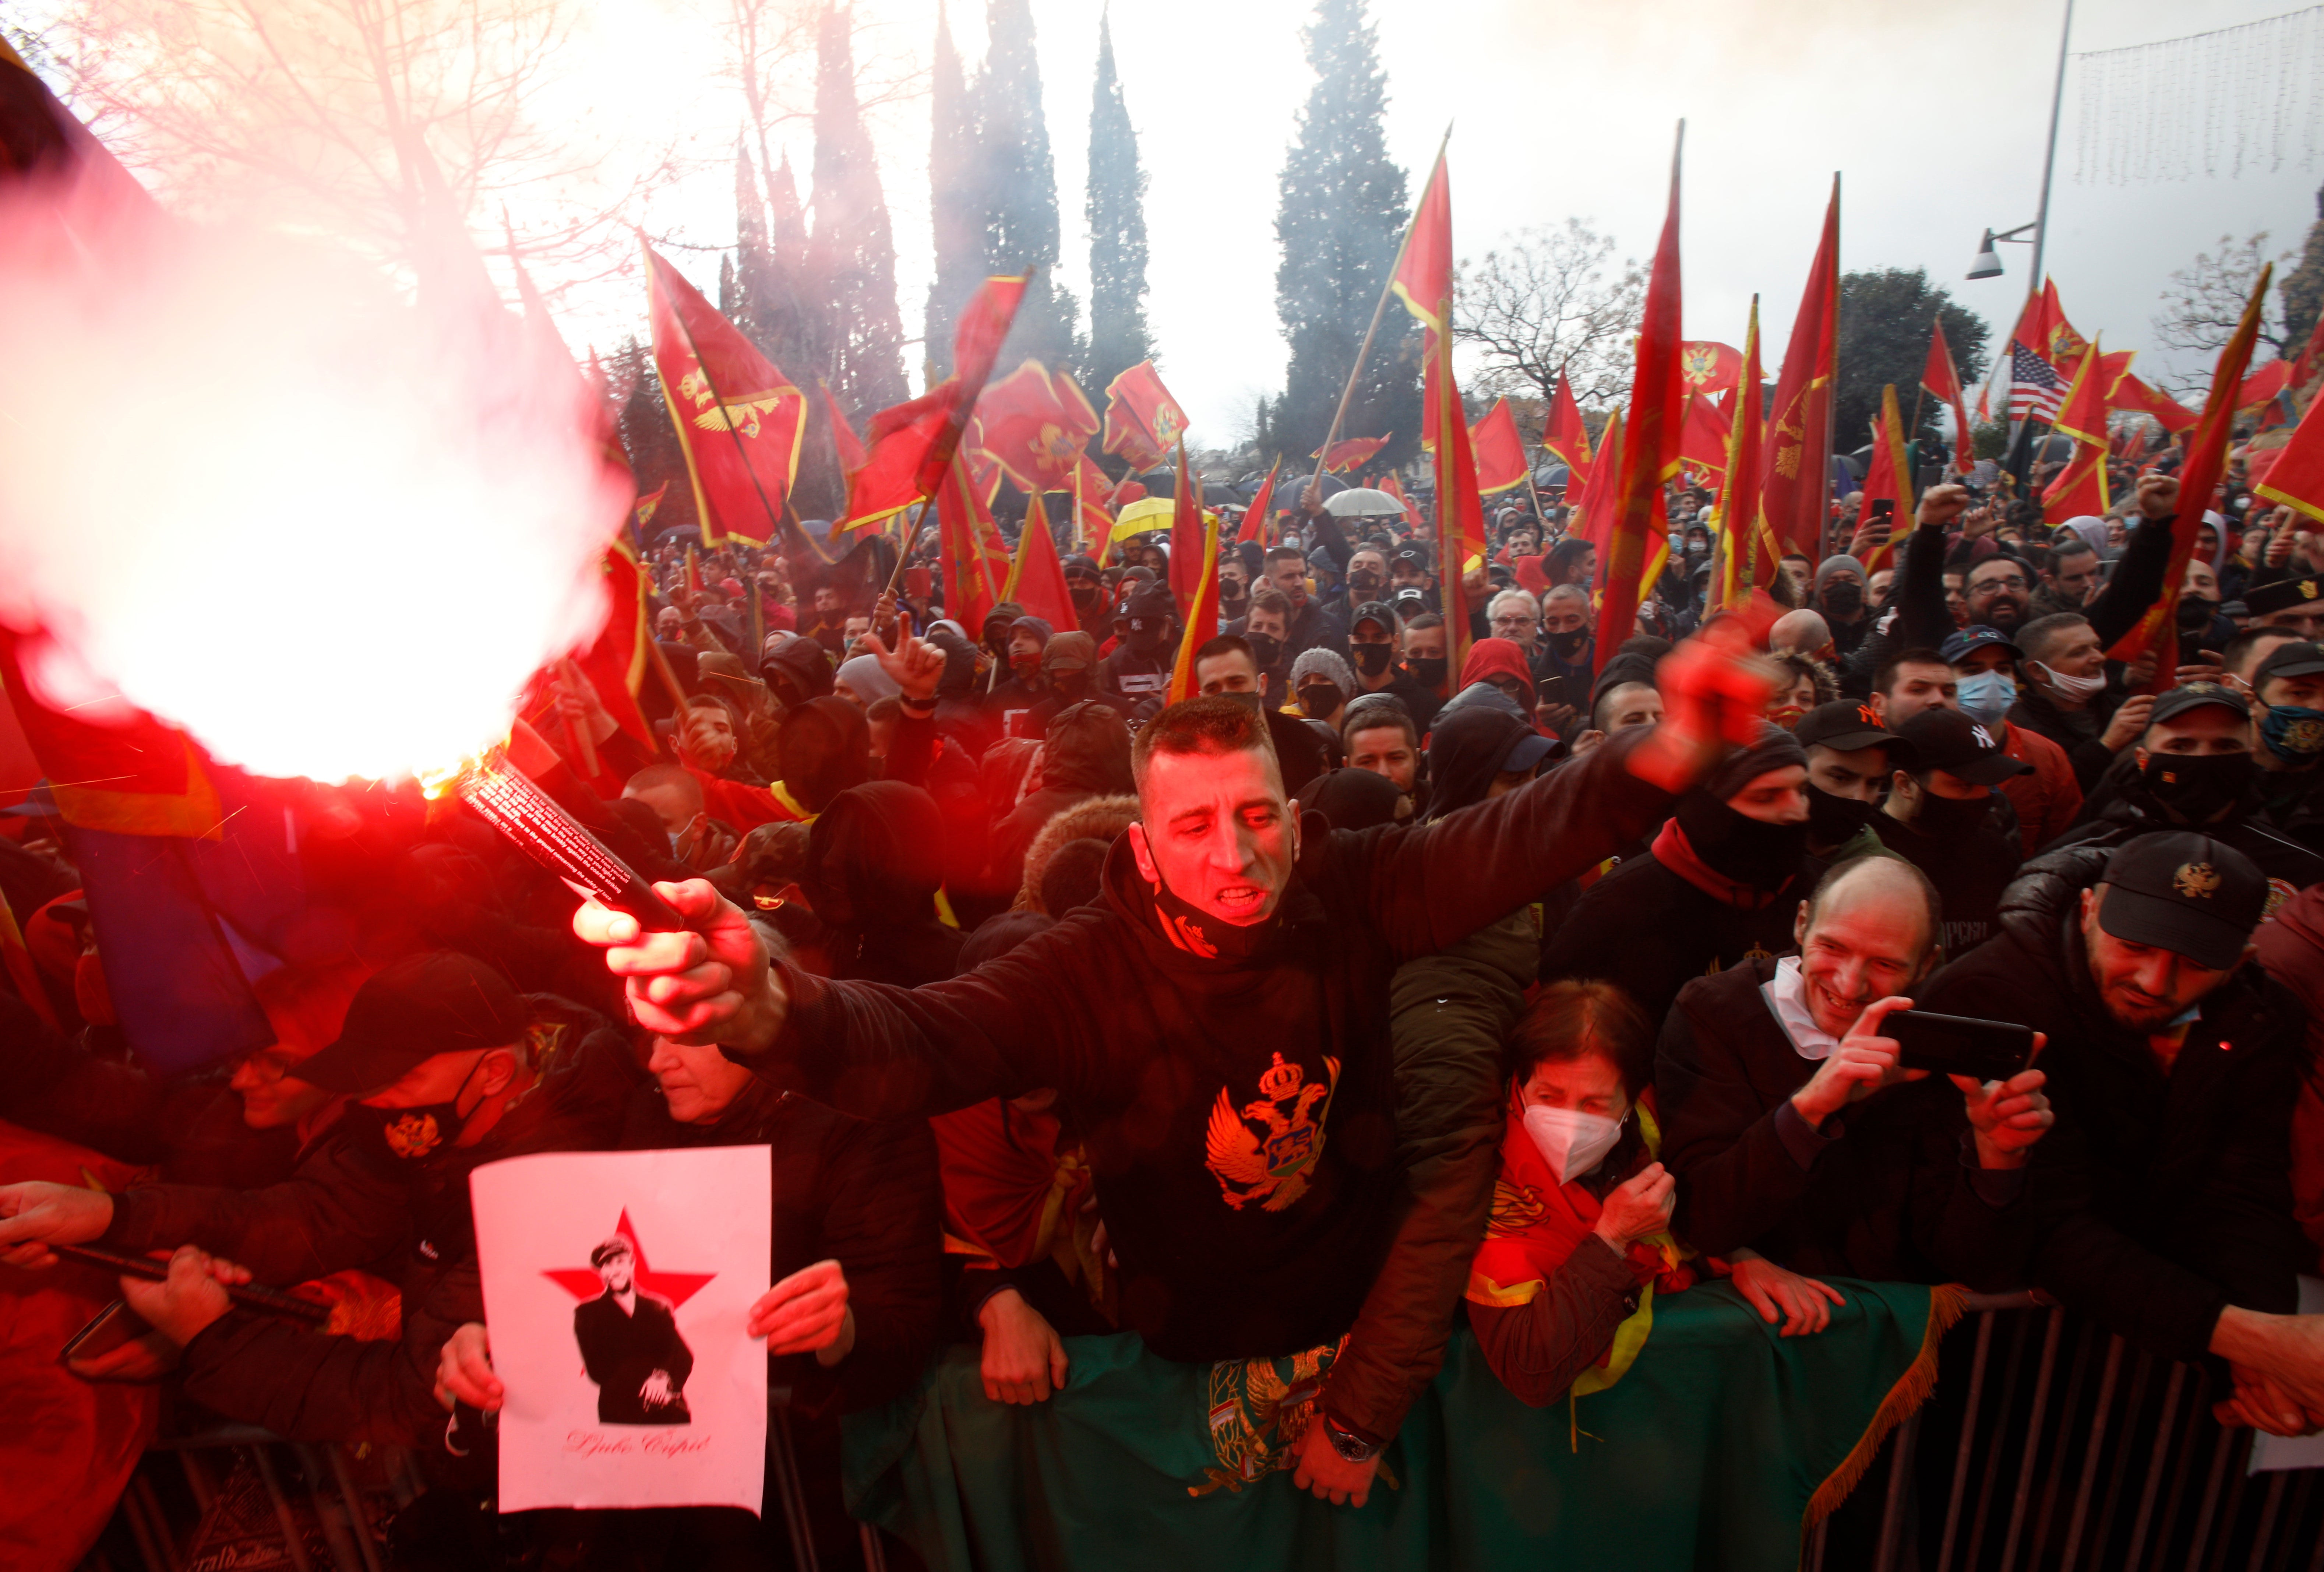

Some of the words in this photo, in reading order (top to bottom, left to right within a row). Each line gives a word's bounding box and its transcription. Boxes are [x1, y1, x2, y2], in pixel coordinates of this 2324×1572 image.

[523, 826, 532, 834] to
[529, 830, 539, 840] the
[536, 836, 555, 854] ground
[552, 850, 578, 873] concerning
[576, 870, 586, 879] the
[582, 876, 599, 890] safety
[531, 816, 542, 826] the
[550, 832, 568, 849] briskly
[565, 845, 584, 862] against
[582, 858, 592, 868] the
[589, 866, 606, 880] coarse
[603, 878, 623, 895] striking
[544, 818, 559, 832] much
[557, 830, 567, 839] the
[565, 837, 579, 850] same
[576, 847, 588, 858] way
[591, 860, 602, 871] you
[600, 867, 613, 879] light
[553, 818, 563, 827] the
[572, 835, 587, 848] Point
[588, 849, 601, 862] away
[600, 858, 612, 869] from
[609, 867, 629, 885] yourself
[557, 815, 570, 827] from
[567, 825, 579, 837] your
[590, 844, 605, 857] Stand
[603, 855, 614, 865] with
[612, 864, 623, 874] your
